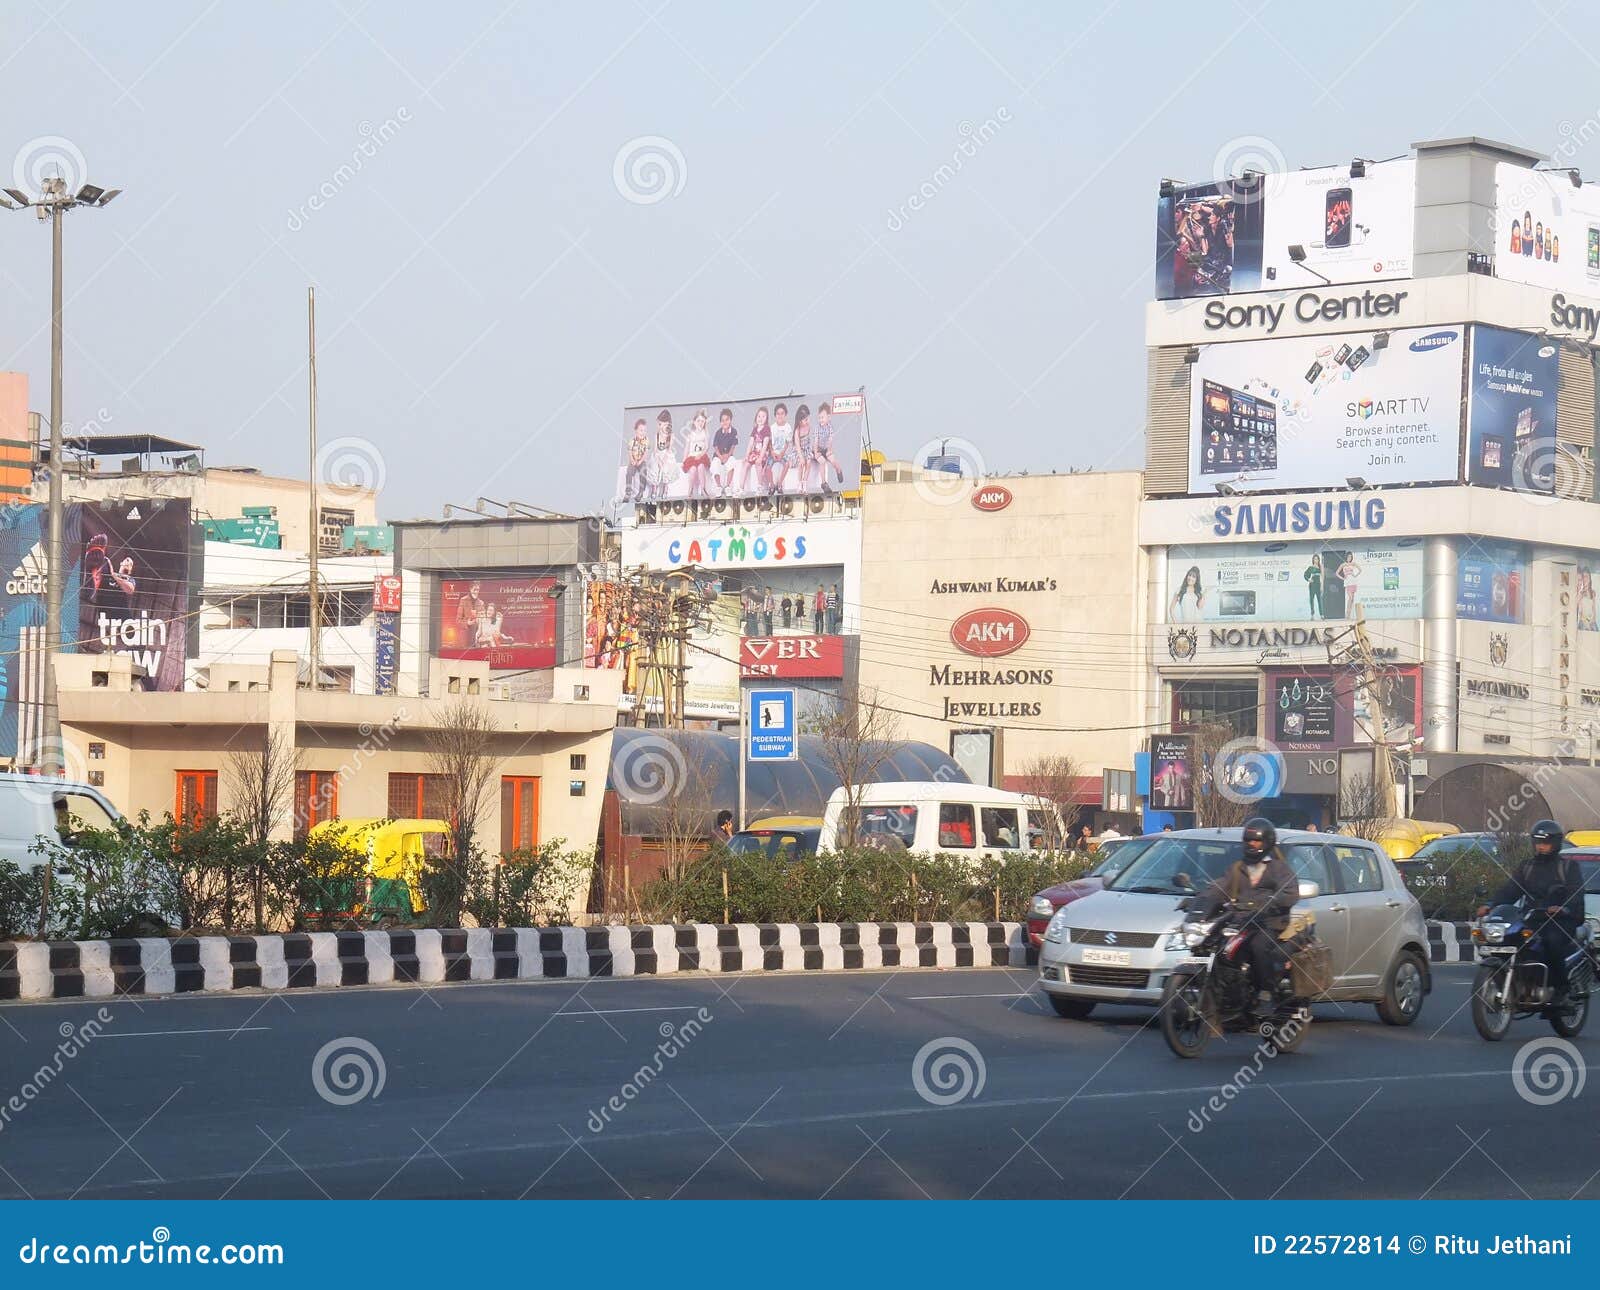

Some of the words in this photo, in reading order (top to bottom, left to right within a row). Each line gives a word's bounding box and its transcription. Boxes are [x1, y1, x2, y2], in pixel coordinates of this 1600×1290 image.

[1204, 300, 1284, 333] Sony
[1295, 290, 1408, 326] Center
[1551, 294, 1600, 336] Sony
[1415, 337, 1453, 347] SAMSUNG
[1479, 364, 1492, 376] Life,
[1492, 366, 1507, 378] from
[1514, 370, 1533, 383] angles
[1410, 397, 1430, 413] TV
[1345, 425, 1382, 437] Browse
[1386, 422, 1430, 434] internet.
[1336, 438, 1372, 449] Search
[1375, 438, 1393, 449] any
[1396, 434, 1439, 445] content.
[1368, 454, 1390, 466] Join
[979, 492, 1004, 505] AKM
[1213, 498, 1386, 537] SAMSUNG
[668, 535, 807, 565] CATMOSS
[6, 575, 48, 595] adid
[930, 578, 992, 594] ASHWANI
[98, 610, 166, 646] train
[966, 622, 1014, 642] AKM
[1209, 627, 1335, 648] NOTANDAS
[929, 664, 1053, 686] MEHRASONS
[944, 697, 1042, 720] JEWELLERS
